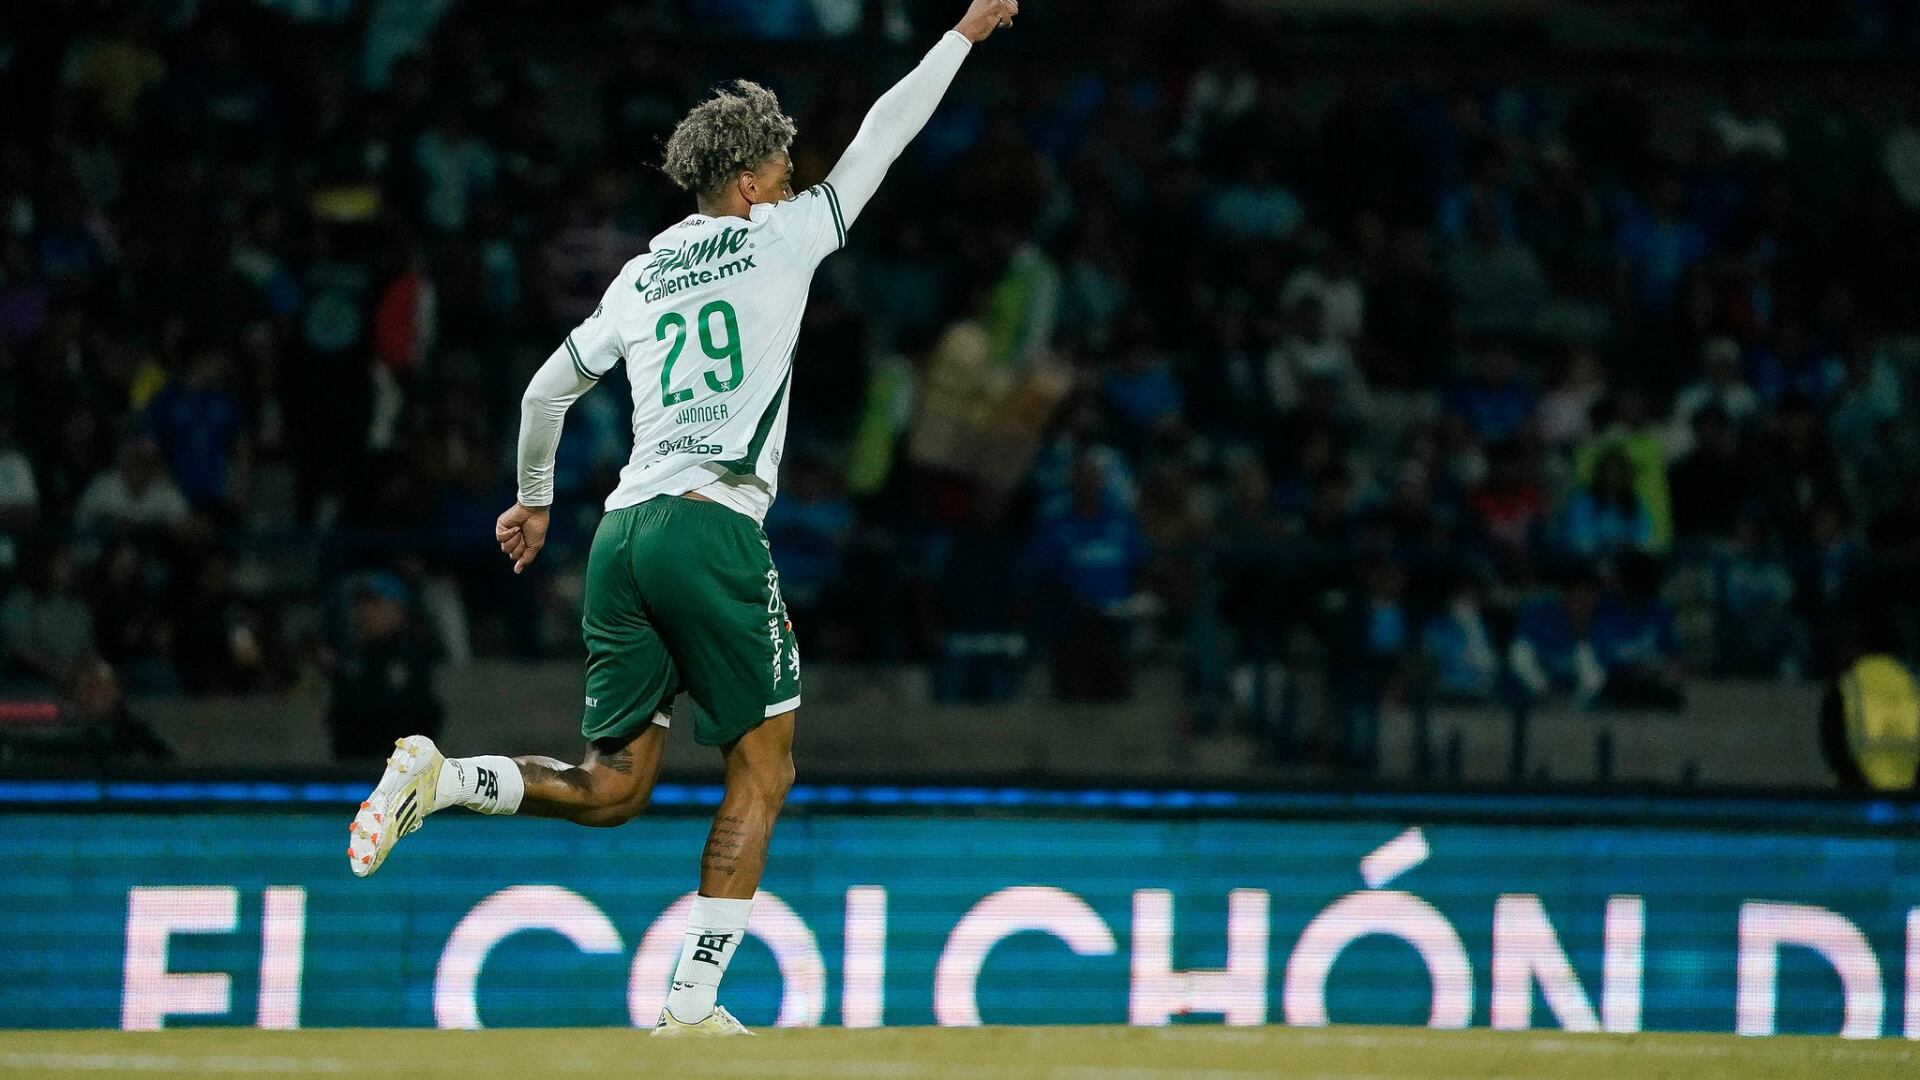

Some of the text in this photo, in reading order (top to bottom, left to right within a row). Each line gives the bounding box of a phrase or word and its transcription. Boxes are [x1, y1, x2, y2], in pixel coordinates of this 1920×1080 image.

[644, 254, 757, 304] caliente.mx
[655, 299, 744, 408] 29
[675, 403, 729, 425] JHONDER
[1735, 899, 1920, 1041] D
